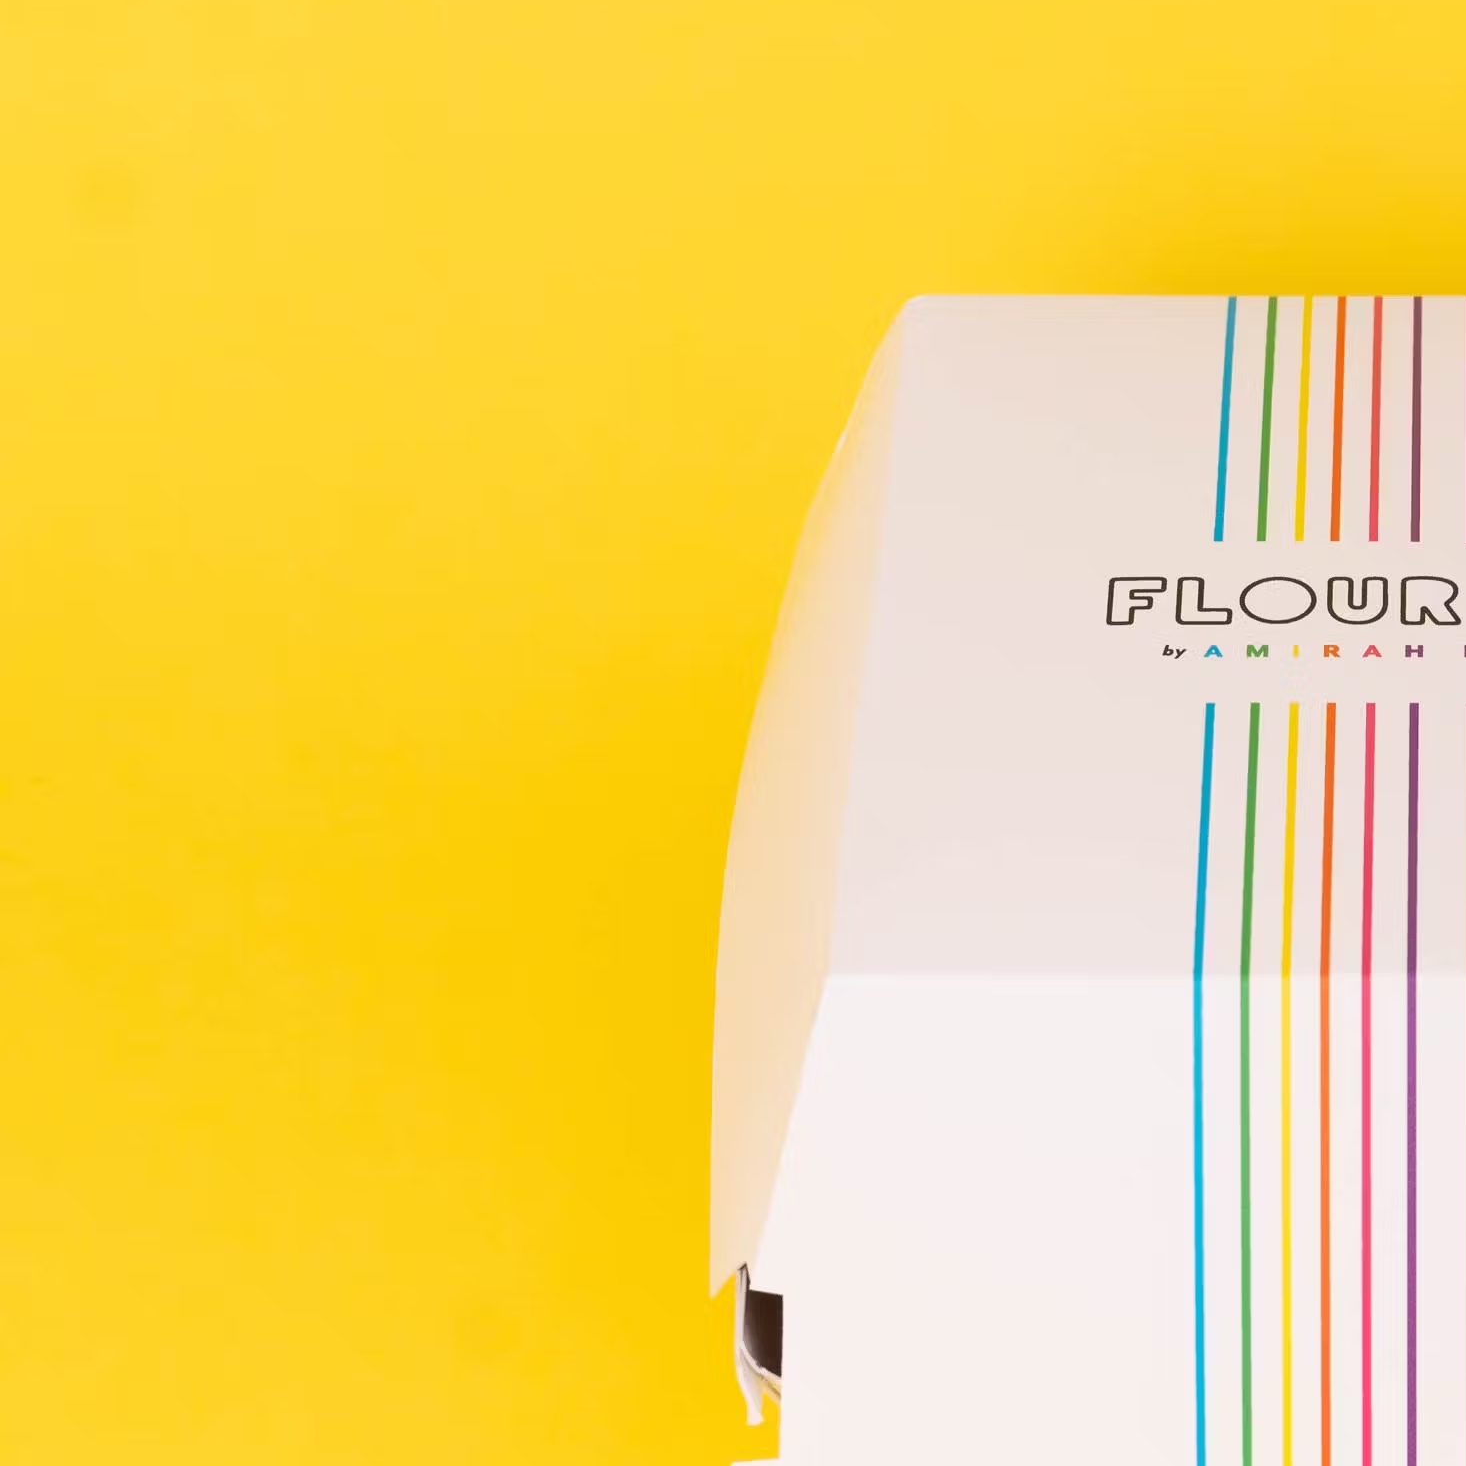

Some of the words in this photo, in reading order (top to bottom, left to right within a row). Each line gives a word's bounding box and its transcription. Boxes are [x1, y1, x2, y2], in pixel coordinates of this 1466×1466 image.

[1105, 575, 1462, 627] FLOUR
[1161, 644, 1187, 660] by
[1203, 644, 1424, 659] AMIRAH
